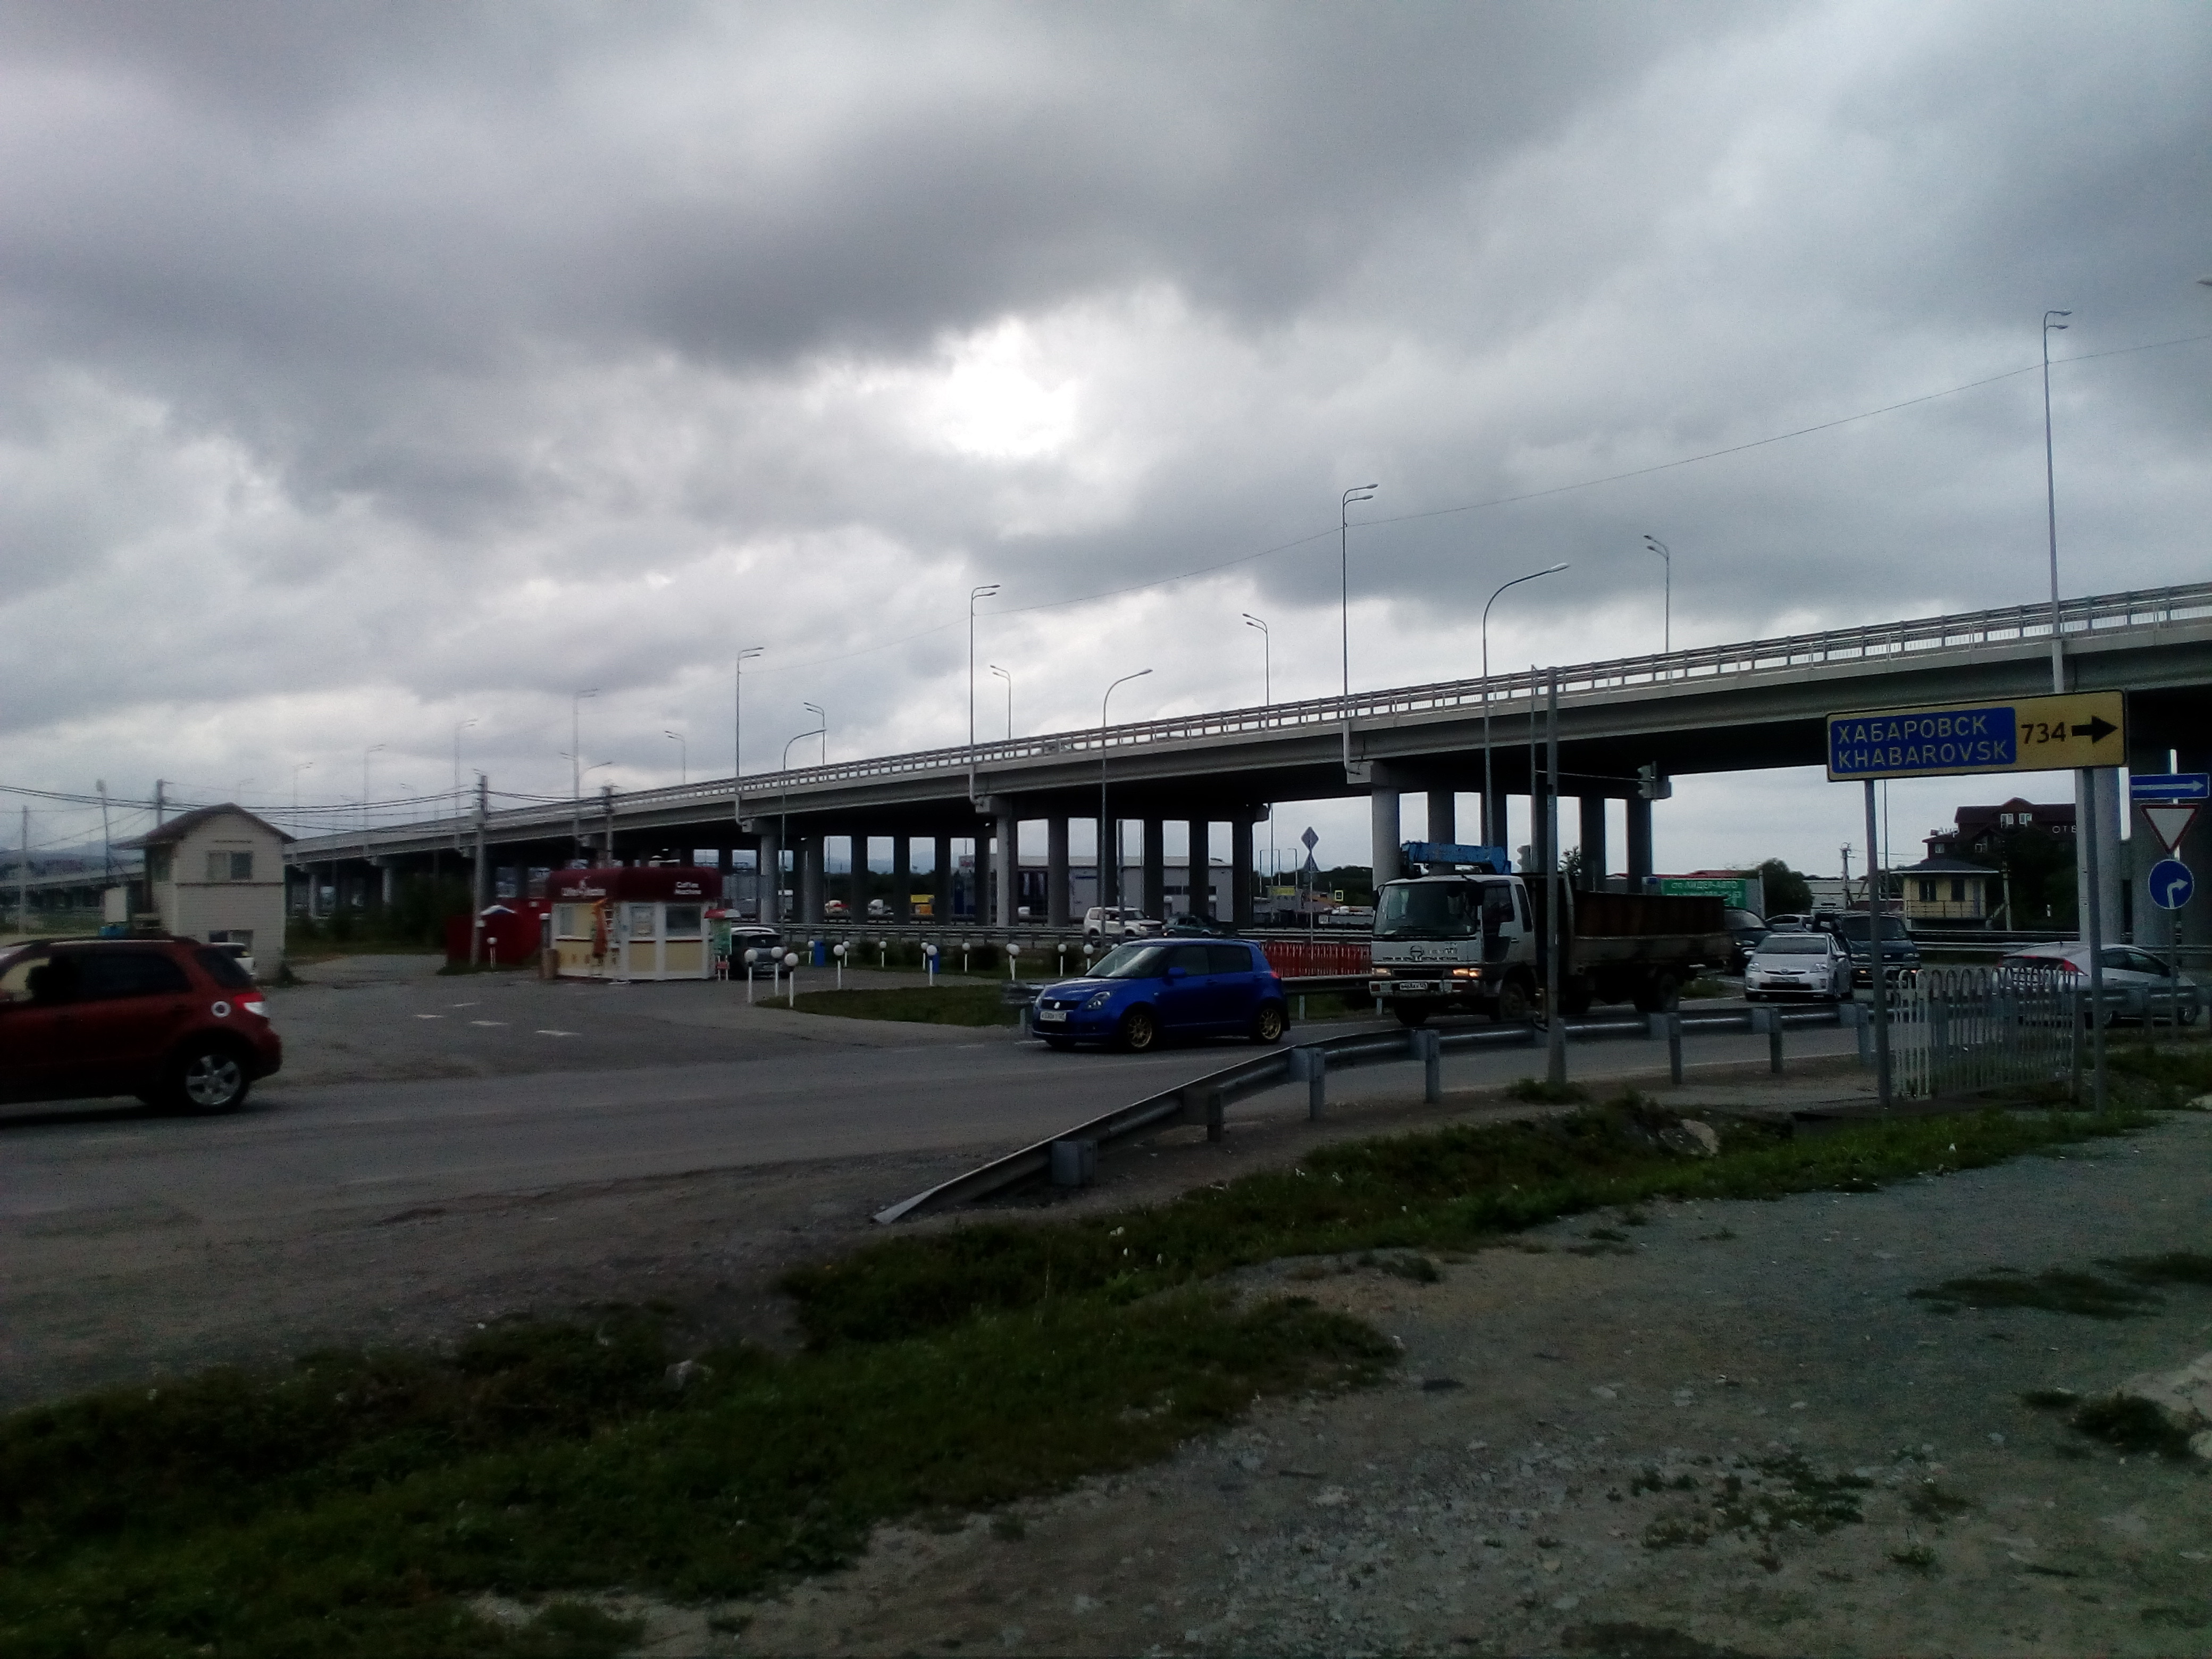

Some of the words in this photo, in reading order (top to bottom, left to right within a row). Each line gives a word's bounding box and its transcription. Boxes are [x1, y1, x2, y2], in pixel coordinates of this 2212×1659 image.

[1838, 715, 1988, 744] ХАБАРОВСК
[2021, 722, 2066, 744] 734
[1838, 740, 2008, 768] KHABAROVSK
